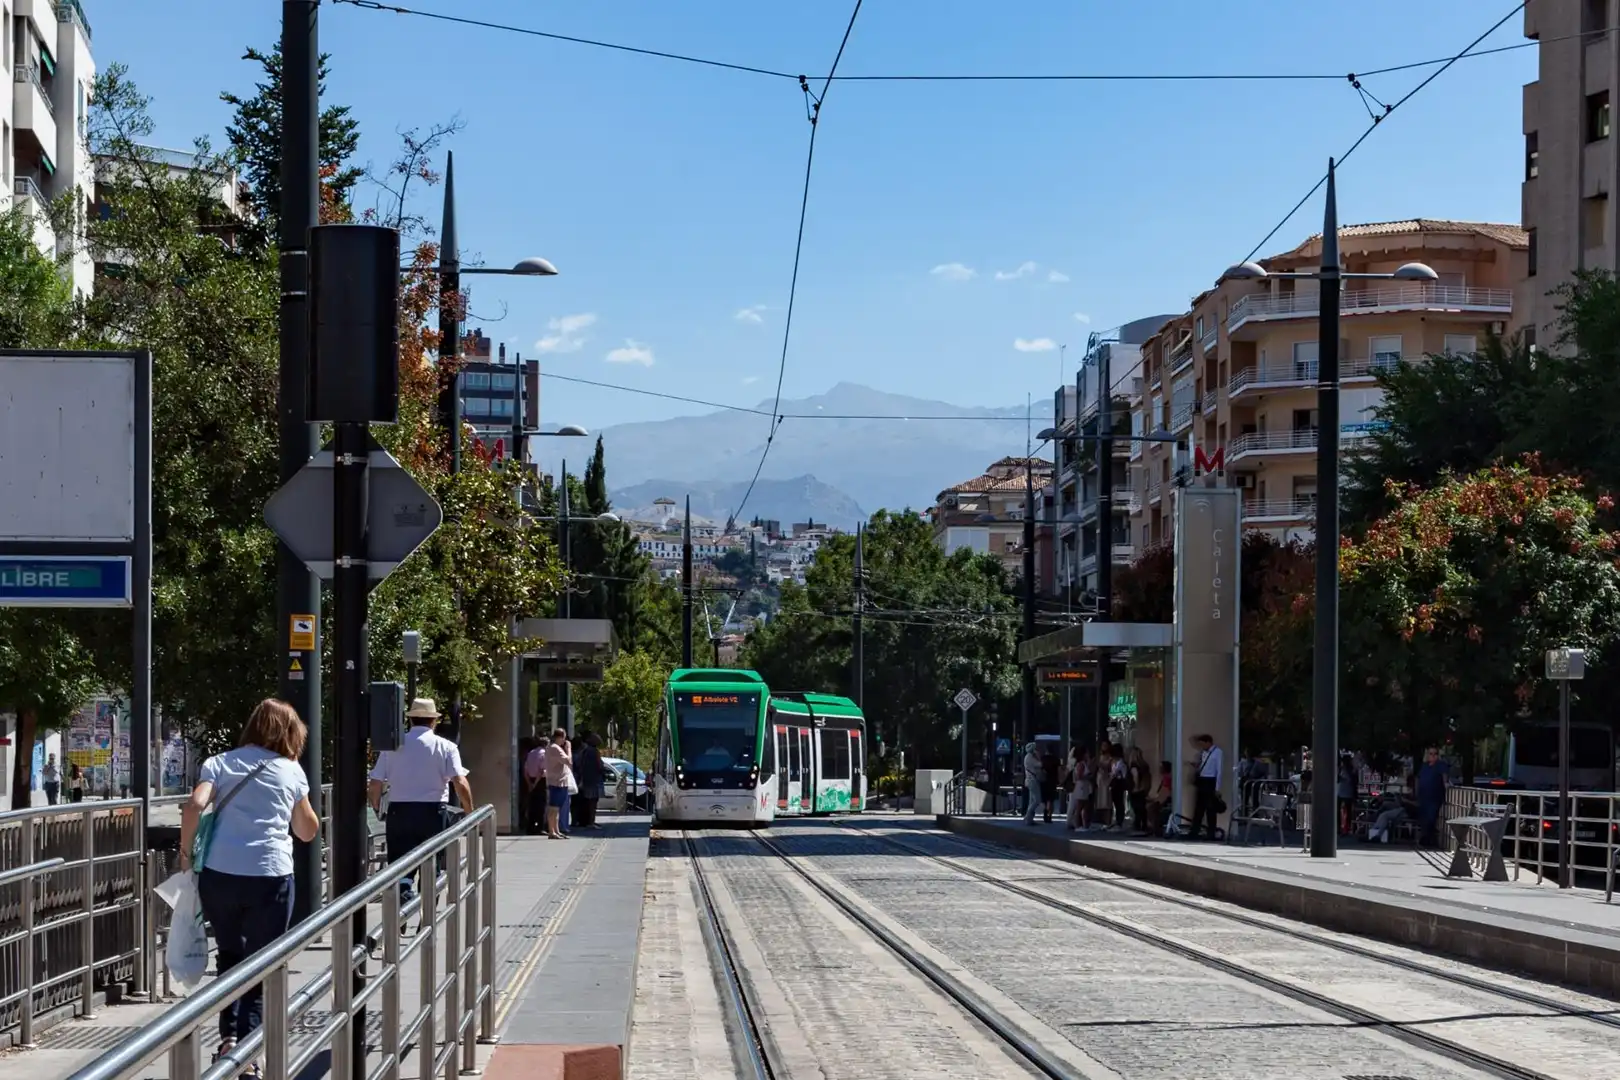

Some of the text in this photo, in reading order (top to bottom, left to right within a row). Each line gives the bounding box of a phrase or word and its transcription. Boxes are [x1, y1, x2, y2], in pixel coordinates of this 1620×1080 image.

[1194, 446, 1224, 473] M
[1, 570, 70, 588] LIBRE
[1212, 529, 1223, 619] Caleta
[960, 695, 971, 704] 20
